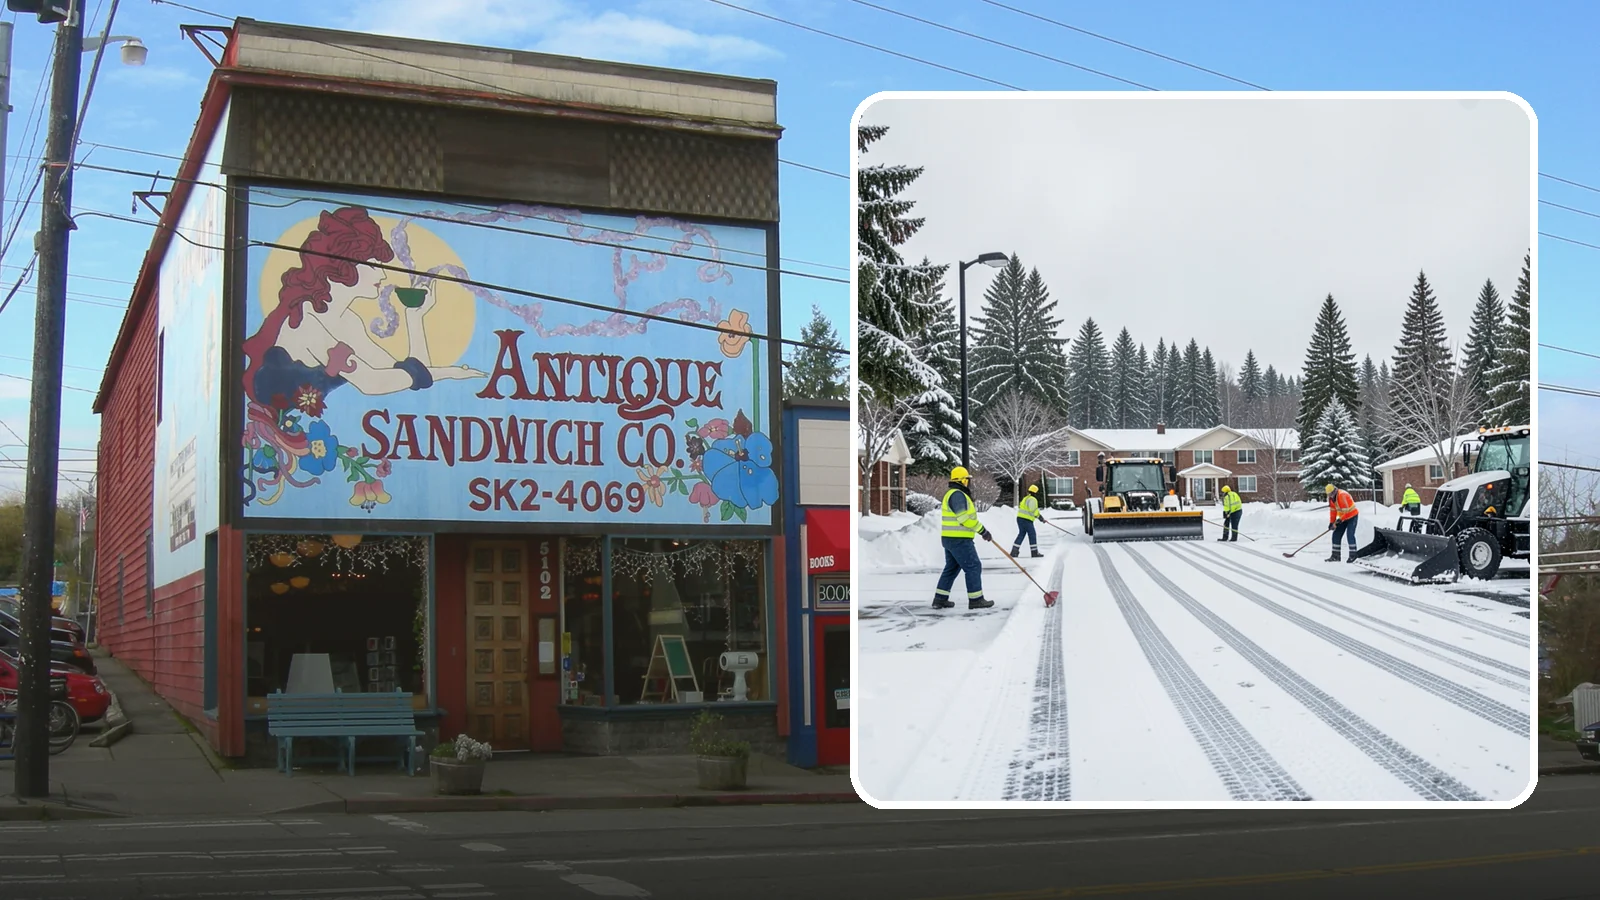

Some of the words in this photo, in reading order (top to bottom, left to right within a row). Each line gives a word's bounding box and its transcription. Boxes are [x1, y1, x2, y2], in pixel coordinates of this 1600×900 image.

[476, 329, 722, 420] ANTIQUE
[362, 409, 604, 467] SANDWICH
[617, 422, 685, 467] CO.
[468, 477, 646, 512] SK2-4069
[540, 541, 552, 600] 5102
[809, 555, 834, 569] BOOKS
